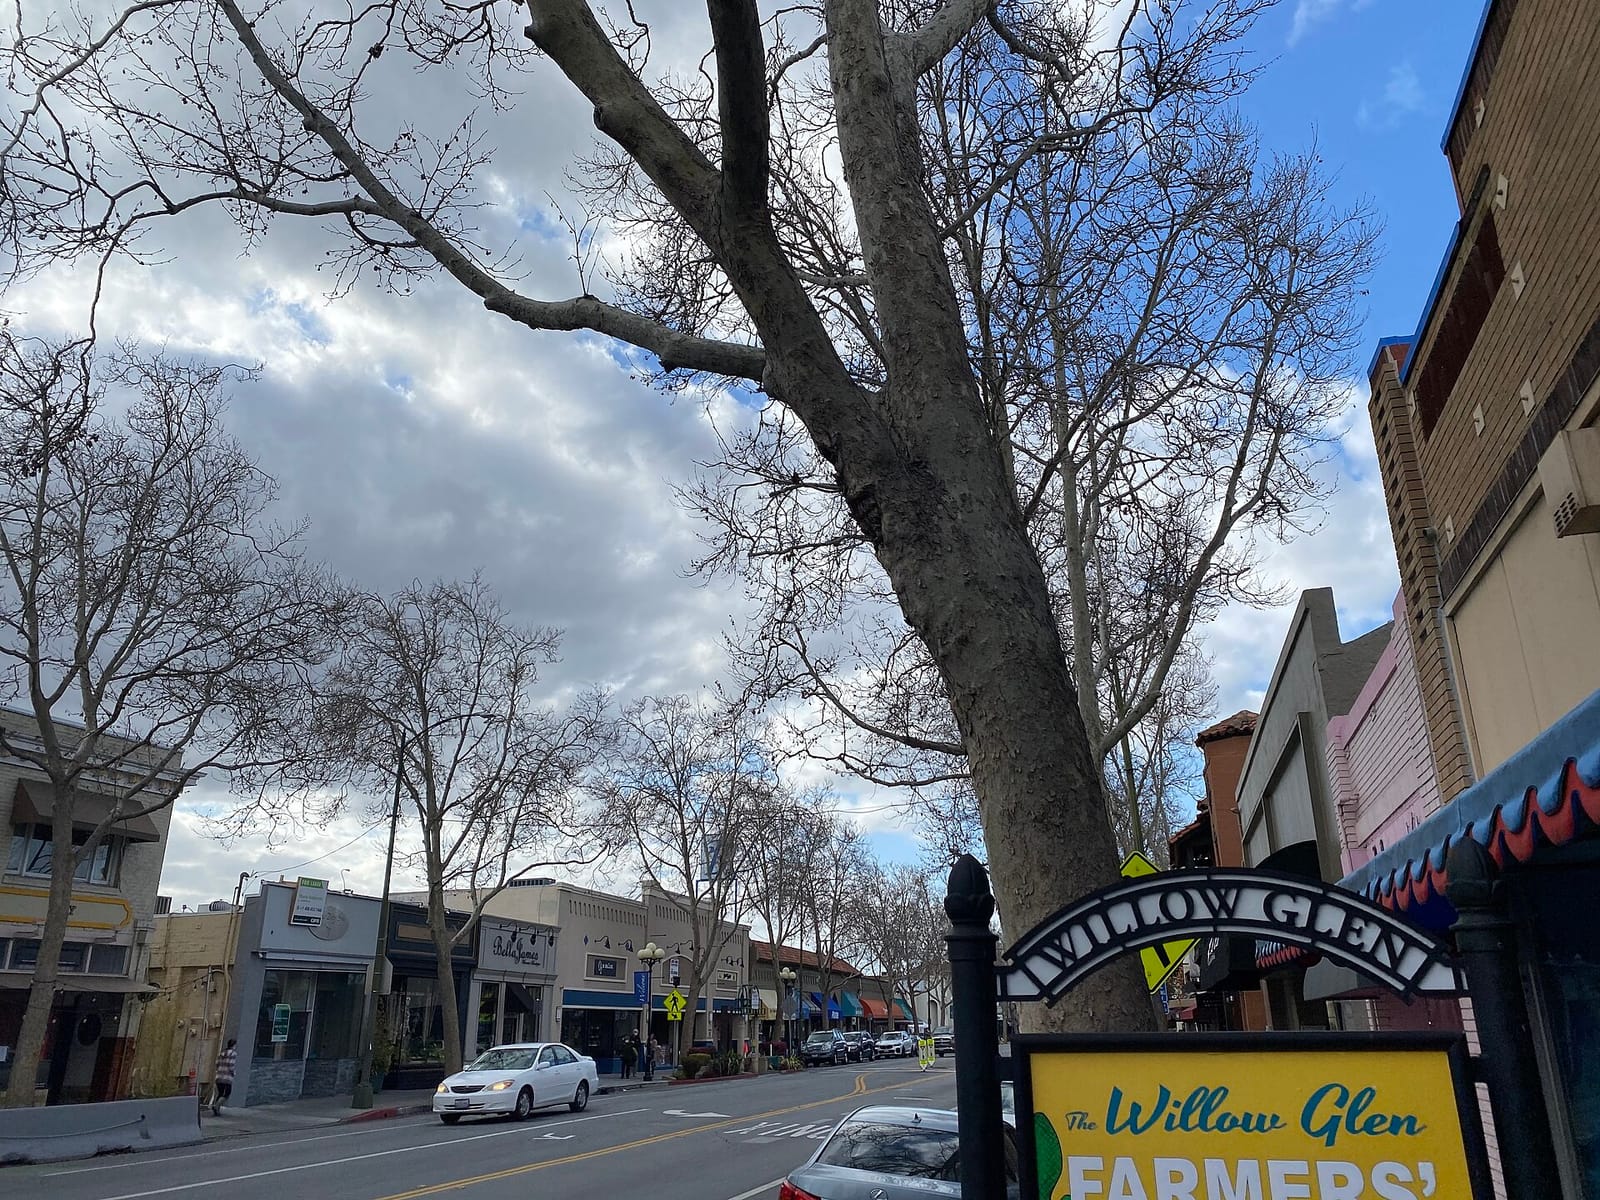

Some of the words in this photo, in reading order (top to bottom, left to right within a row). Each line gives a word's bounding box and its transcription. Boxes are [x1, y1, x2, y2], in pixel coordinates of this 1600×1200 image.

[493, 935, 517, 958] Bella
[514, 937, 539, 965] James
[1033, 886, 1242, 970] WILLOW
[1262, 888, 1411, 971] GLEN
[1065, 1111, 1098, 1131] The
[1105, 1084, 1287, 1135] Willow
[1301, 1082, 1428, 1147] Glen
[1066, 1155, 1437, 1200] FARMERS'
